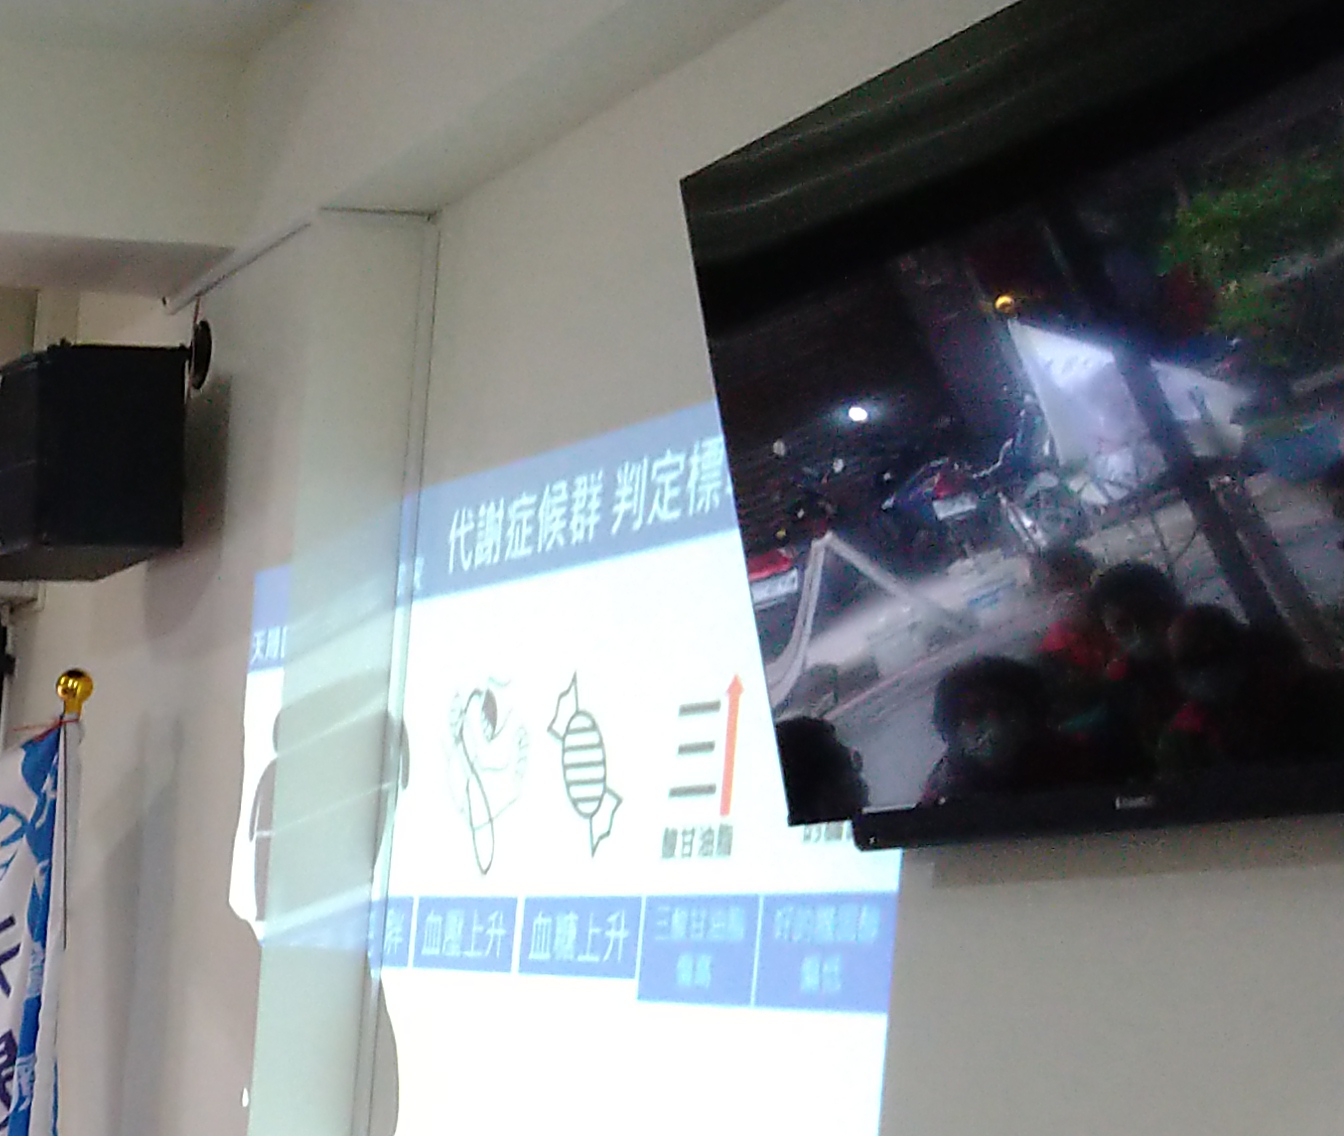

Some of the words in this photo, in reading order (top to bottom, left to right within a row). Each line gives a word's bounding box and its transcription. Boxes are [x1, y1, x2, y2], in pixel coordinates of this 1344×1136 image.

[448, 468, 604, 575] 代謝症候群
[611, 434, 734, 536] 判定標
